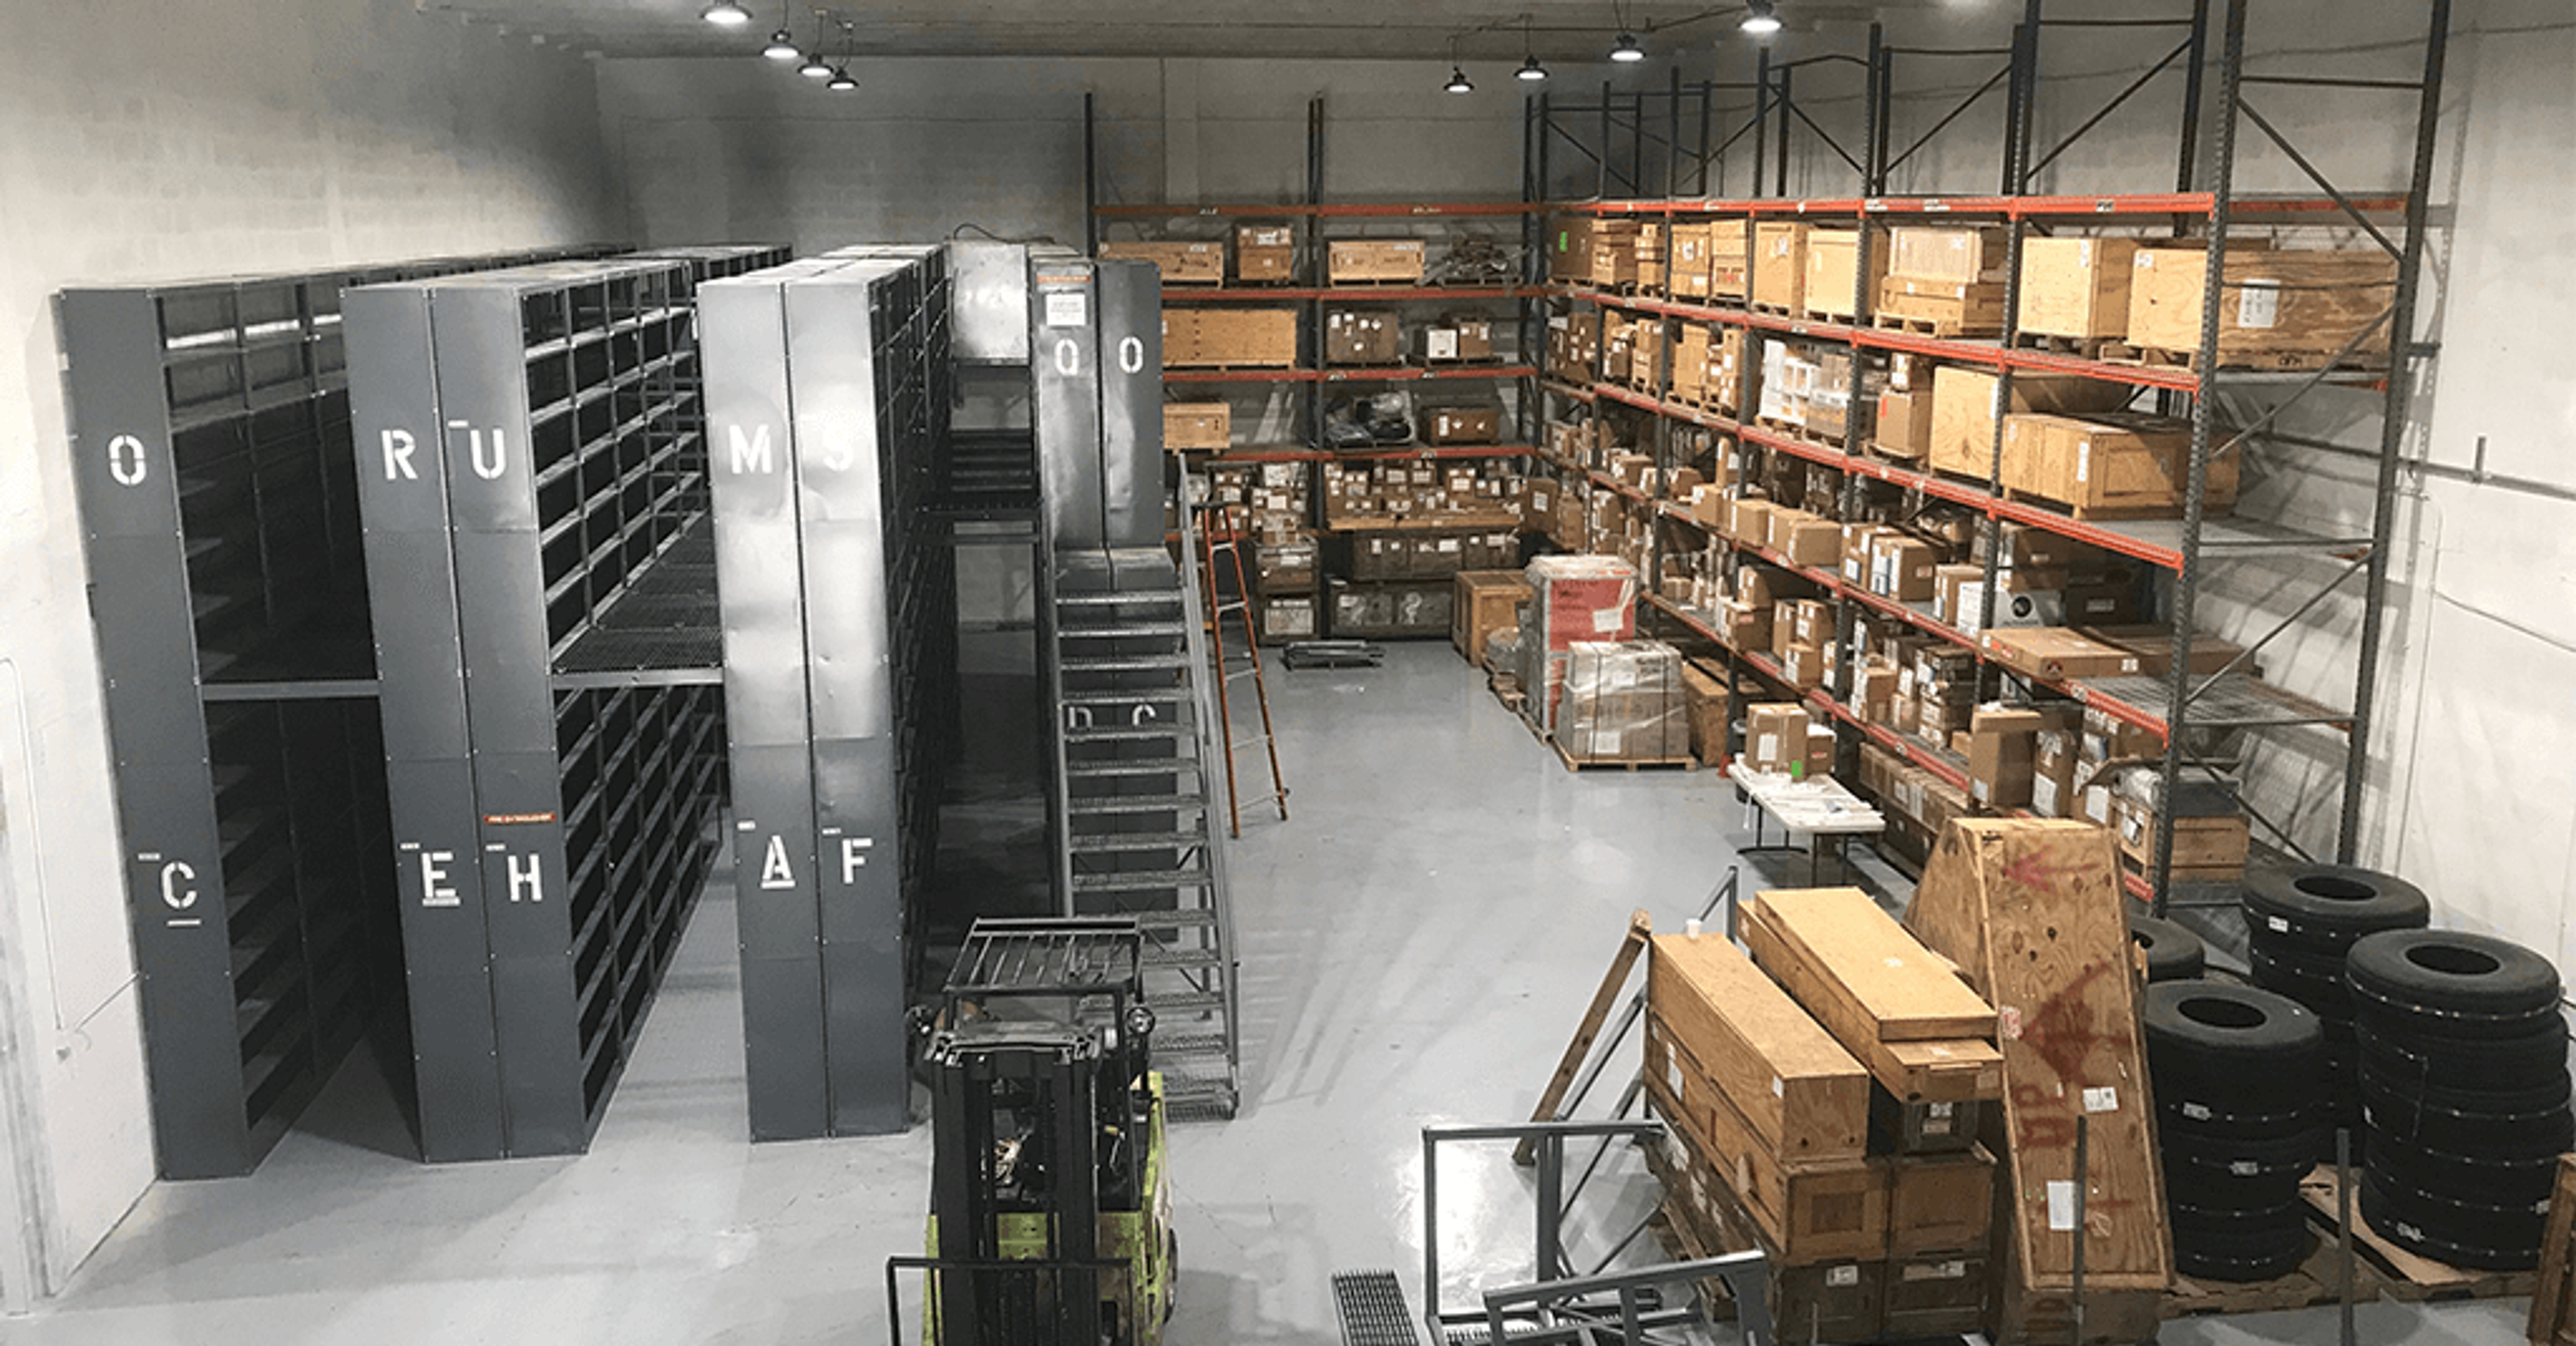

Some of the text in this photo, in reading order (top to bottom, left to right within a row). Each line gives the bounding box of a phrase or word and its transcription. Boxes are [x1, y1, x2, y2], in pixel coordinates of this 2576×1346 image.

[1055, 338, 1079, 375] Q
[382, 429, 417, 480] R
[471, 429, 506, 478] U
[729, 424, 771, 473] M
[421, 851, 460, 900] E
[508, 854, 543, 902] H
[762, 835, 794, 880] A
[842, 838, 872, 884] F
[162, 862, 197, 909] C
